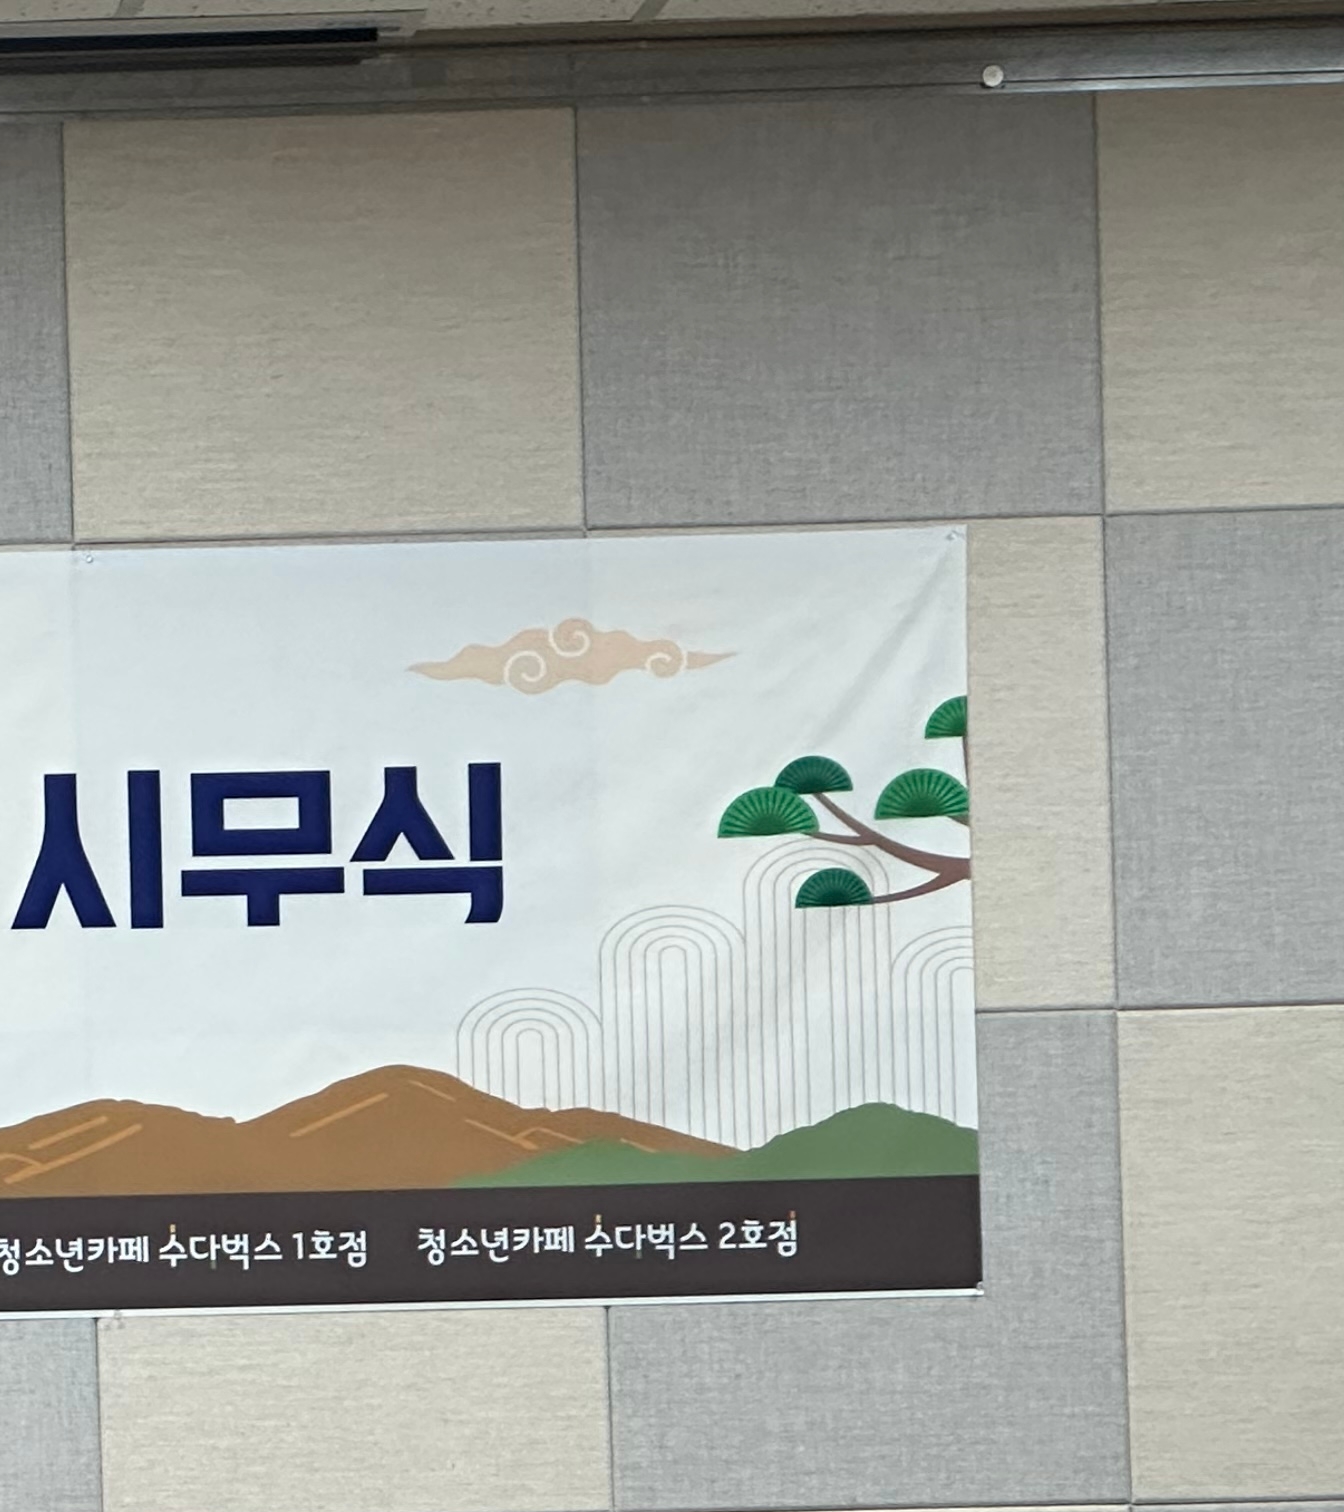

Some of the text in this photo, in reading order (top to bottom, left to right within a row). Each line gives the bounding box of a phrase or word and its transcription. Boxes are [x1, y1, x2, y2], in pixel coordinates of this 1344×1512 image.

[10, 762, 504, 930] 시무식
[158, 1225, 283, 1271] 수다벅스
[292, 1229, 367, 1268] 1호점
[417, 1211, 798, 1266] 청소년카페 수다벅스 2호점
